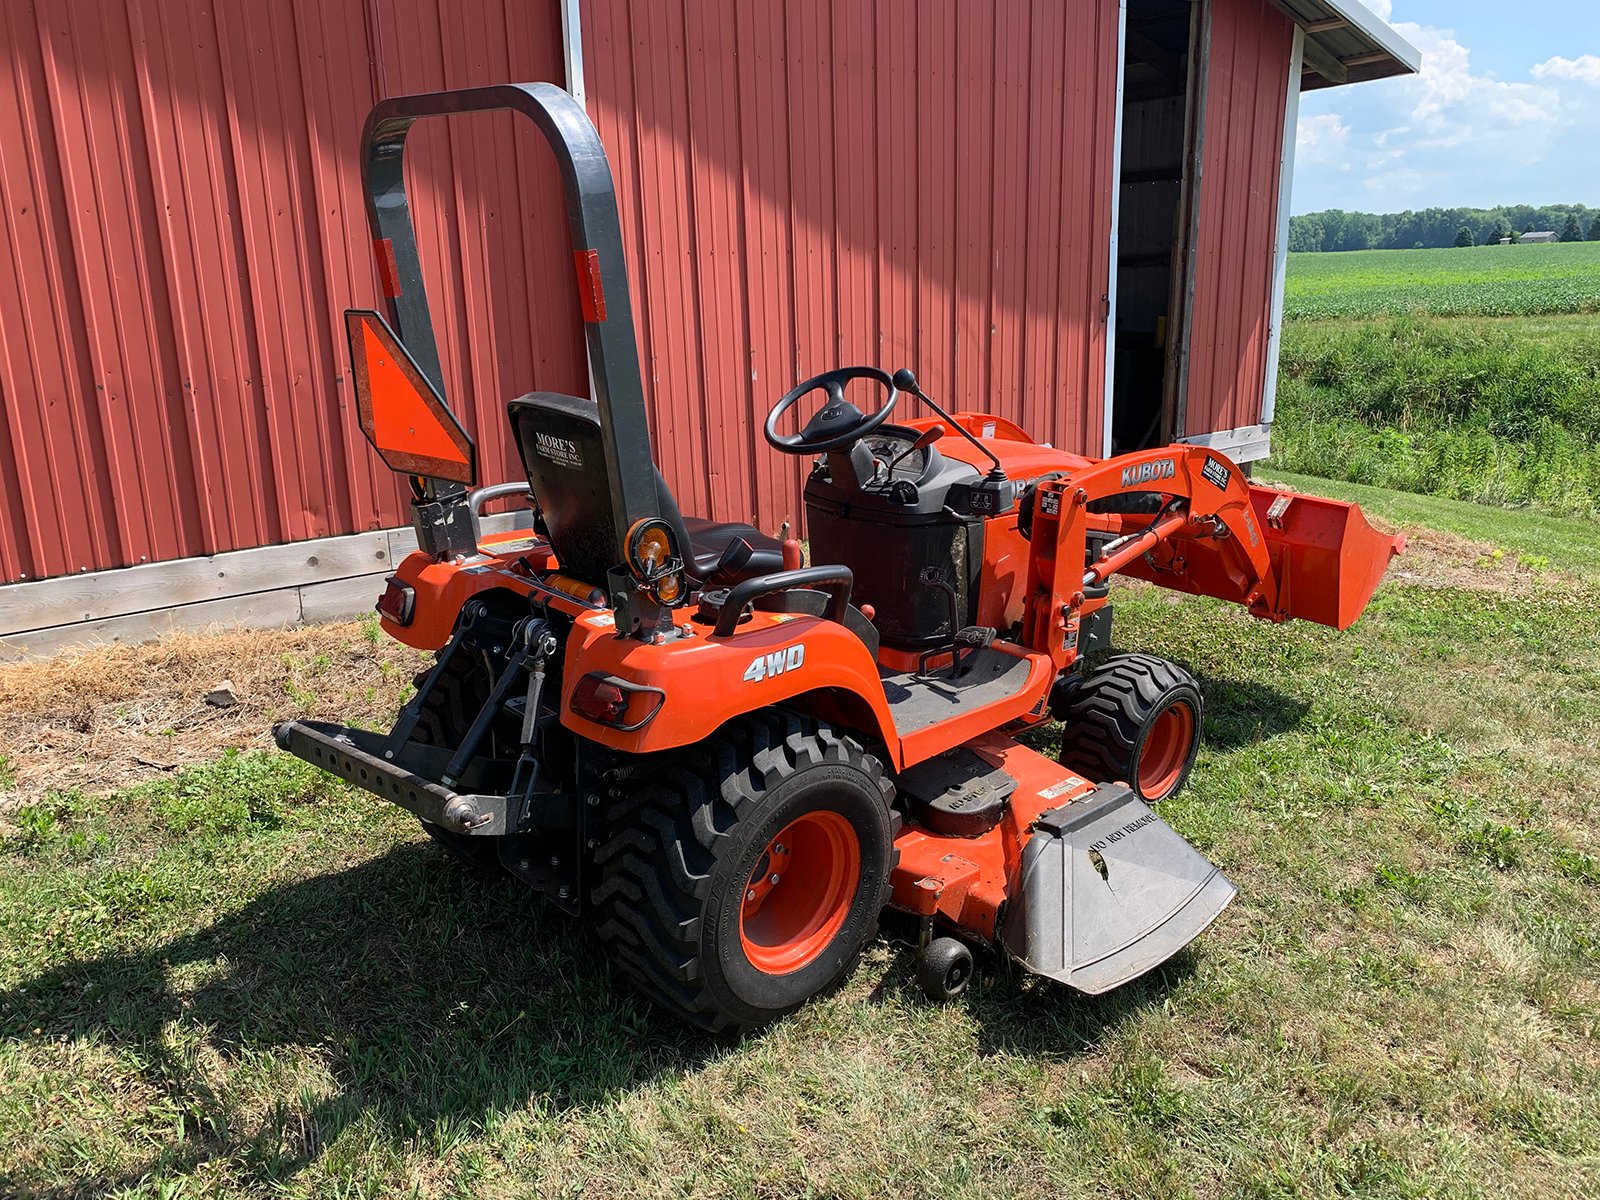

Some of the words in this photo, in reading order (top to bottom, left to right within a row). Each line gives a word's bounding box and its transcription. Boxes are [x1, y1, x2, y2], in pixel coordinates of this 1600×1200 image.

[535, 431, 576, 454] MORE'S
[1120, 458, 1176, 488] KUBOTA
[741, 642, 805, 683] 4WD
[1089, 840, 1108, 853] DO
[1105, 829, 1126, 844] NOT
[1122, 813, 1158, 835] REMOVE
